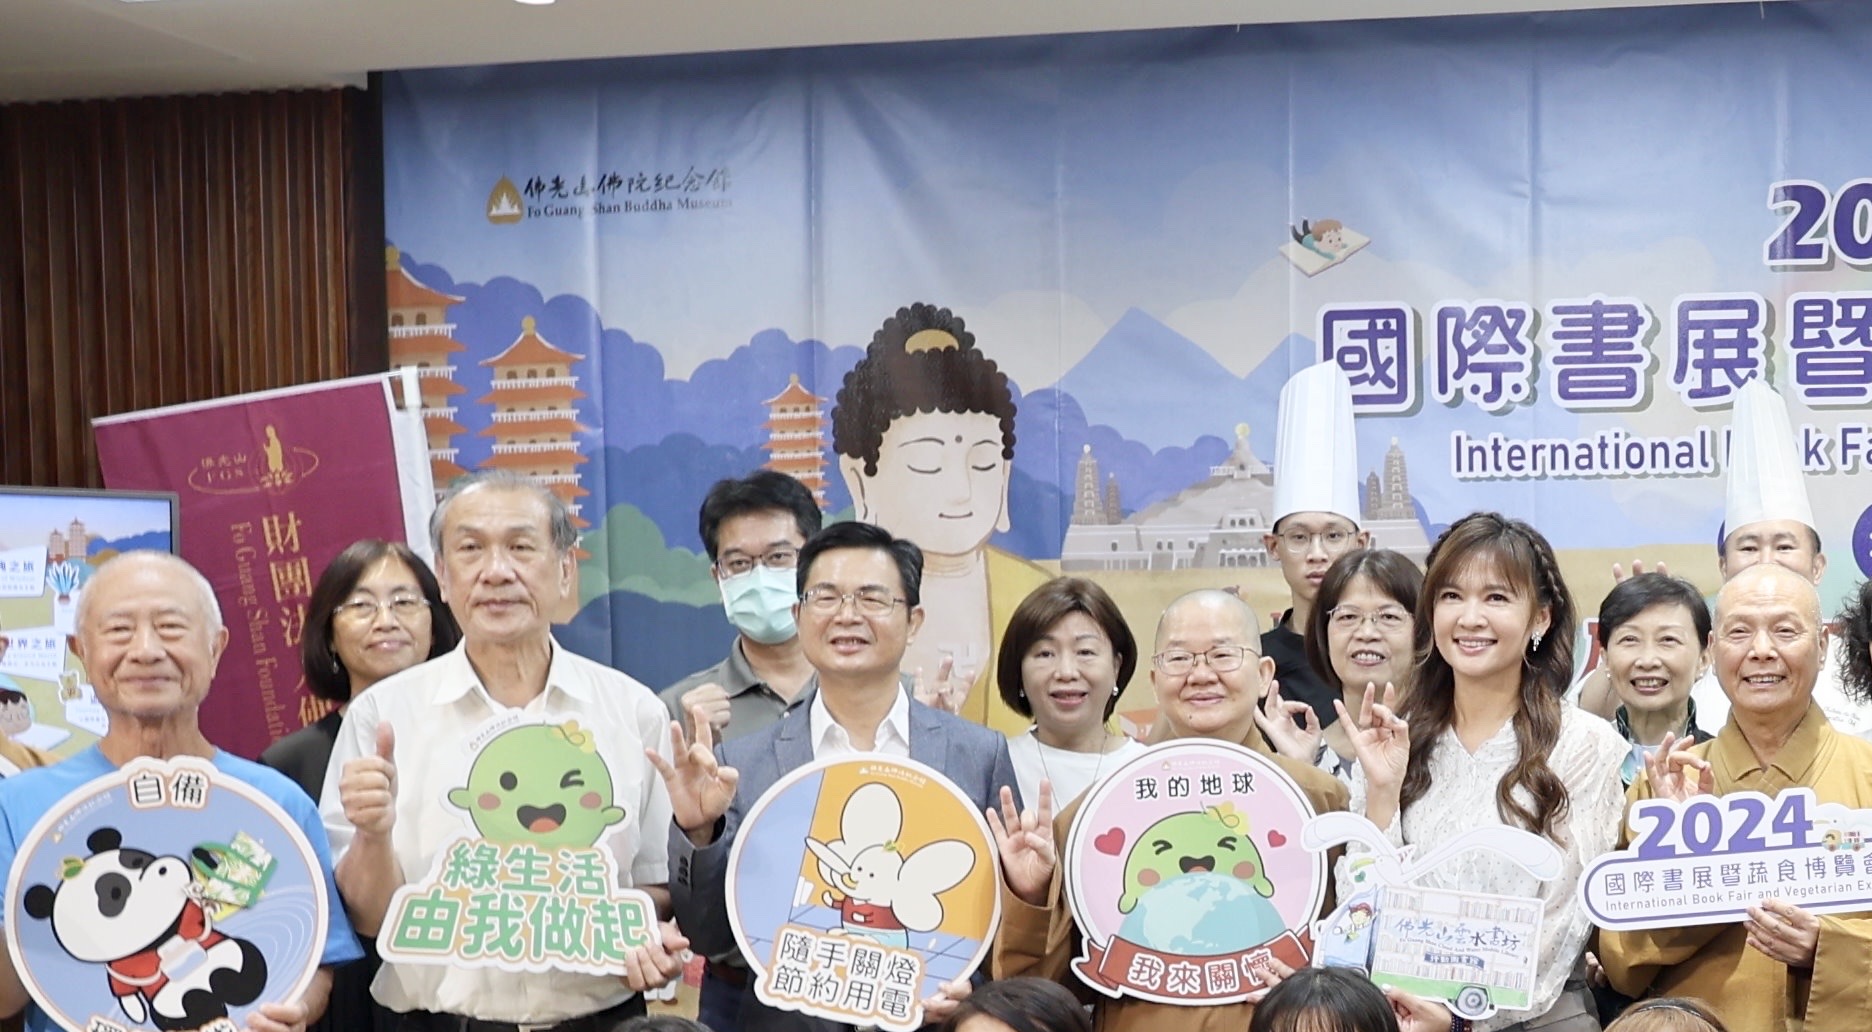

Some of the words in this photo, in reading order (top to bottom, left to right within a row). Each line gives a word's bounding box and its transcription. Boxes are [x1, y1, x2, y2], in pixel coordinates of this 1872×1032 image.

[527, 207, 541, 218] Fo
[543, 205, 583, 219] Guang
[592, 202, 621, 215] Shan
[624, 200, 673, 213] Buddha
[677, 197, 732, 210] Museum
[1455, 430, 1710, 473] International
[230, 521, 253, 543] Fo
[232, 545, 258, 606] Guang
[247, 608, 267, 655] Shan
[134, 773, 204, 804] 自備
[1135, 771, 1255, 800] 我的地球
[1637, 794, 1814, 860] 2024
[443, 842, 606, 896] 綠生活
[1605, 895, 1687, 912] International
[1693, 892, 1723, 905] Book
[1728, 889, 1752, 902] Fair
[1758, 888, 1781, 900] and
[1785, 882, 1854, 900] Vegetarian
[392, 888, 649, 961] 由我做起
[780, 932, 916, 987] 隨手關燈
[773, 964, 910, 1018] 節約用電
